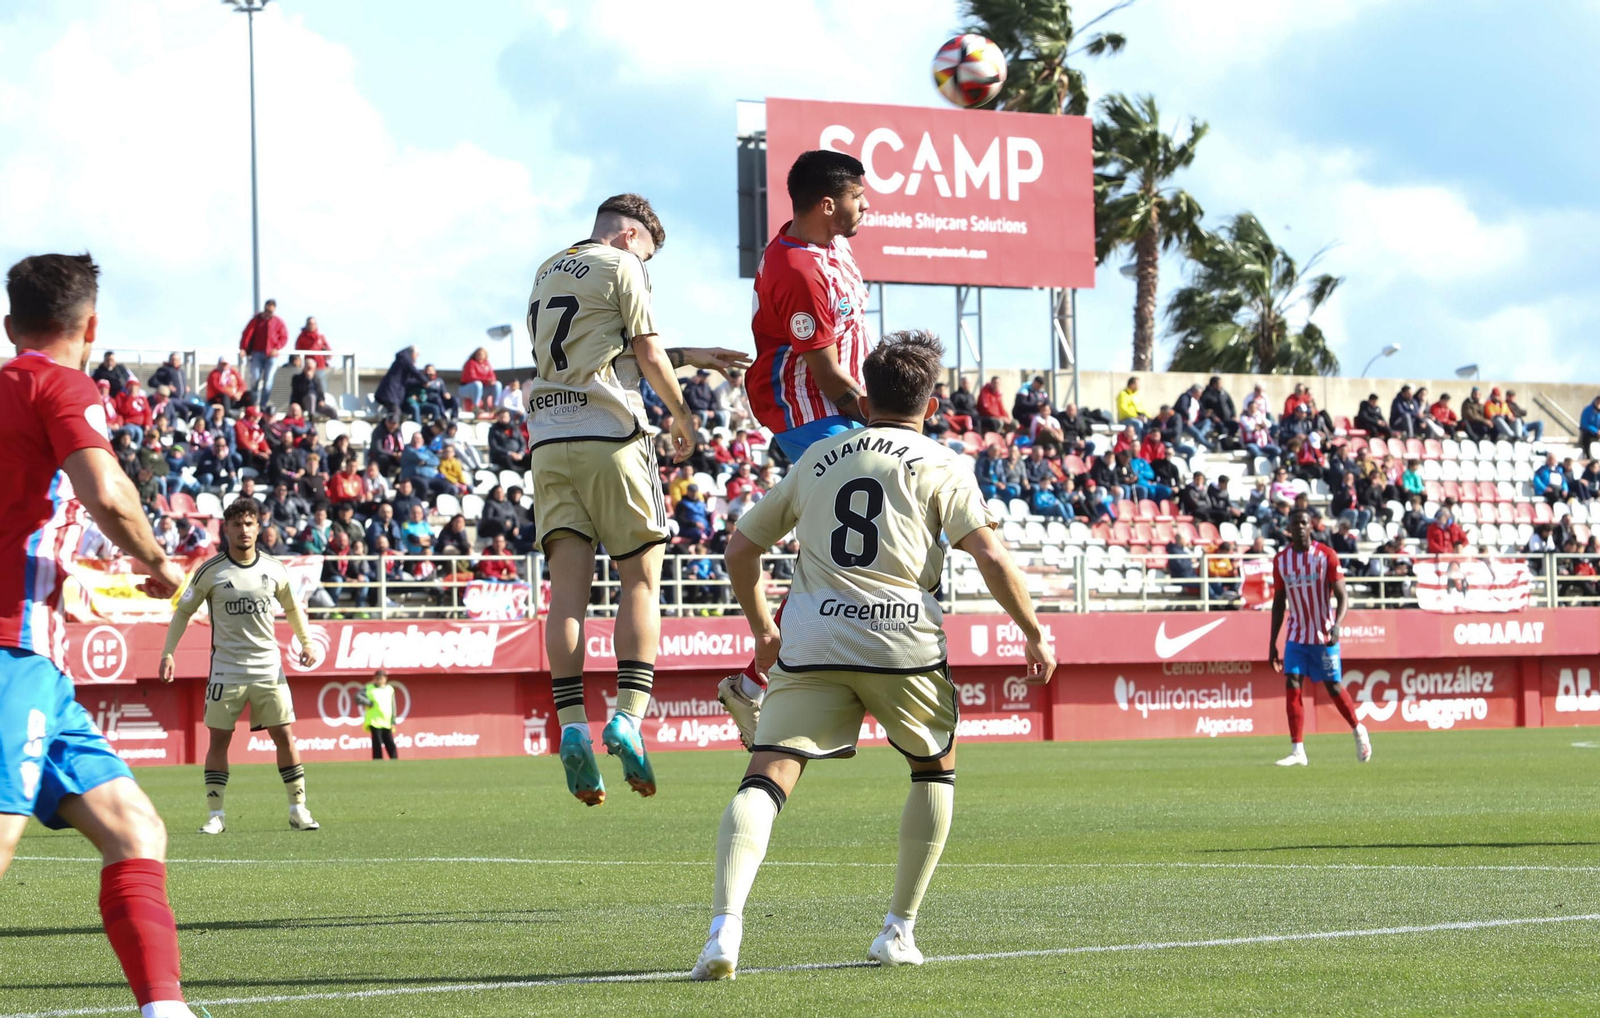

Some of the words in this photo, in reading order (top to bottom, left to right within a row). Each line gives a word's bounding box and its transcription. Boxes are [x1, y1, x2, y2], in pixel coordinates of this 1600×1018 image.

[859, 211, 913, 229] tainable
[915, 212, 968, 233] Shipcare
[970, 215, 1028, 235] Solutions
[528, 295, 579, 372] 17
[553, 405, 579, 415] Group
[813, 437, 910, 477] JUANMA
[830, 477, 884, 568] 8
[225, 597, 270, 616] wiber
[819, 598, 919, 624] Greening
[870, 620, 906, 634] Group
[996, 619, 1056, 642] FÚTL
[1454, 621, 1544, 644] OBRAMAT
[662, 631, 734, 656] MUÑOZ
[1401, 665, 1494, 694] González
[1134, 682, 1253, 718] quirónsalud
[1402, 695, 1488, 729] Gaggero
[657, 723, 677, 743] de
[1196, 715, 1253, 737] Algeciras
[339, 734, 372, 750] Cam
[414, 731, 480, 748] Gibraltar
